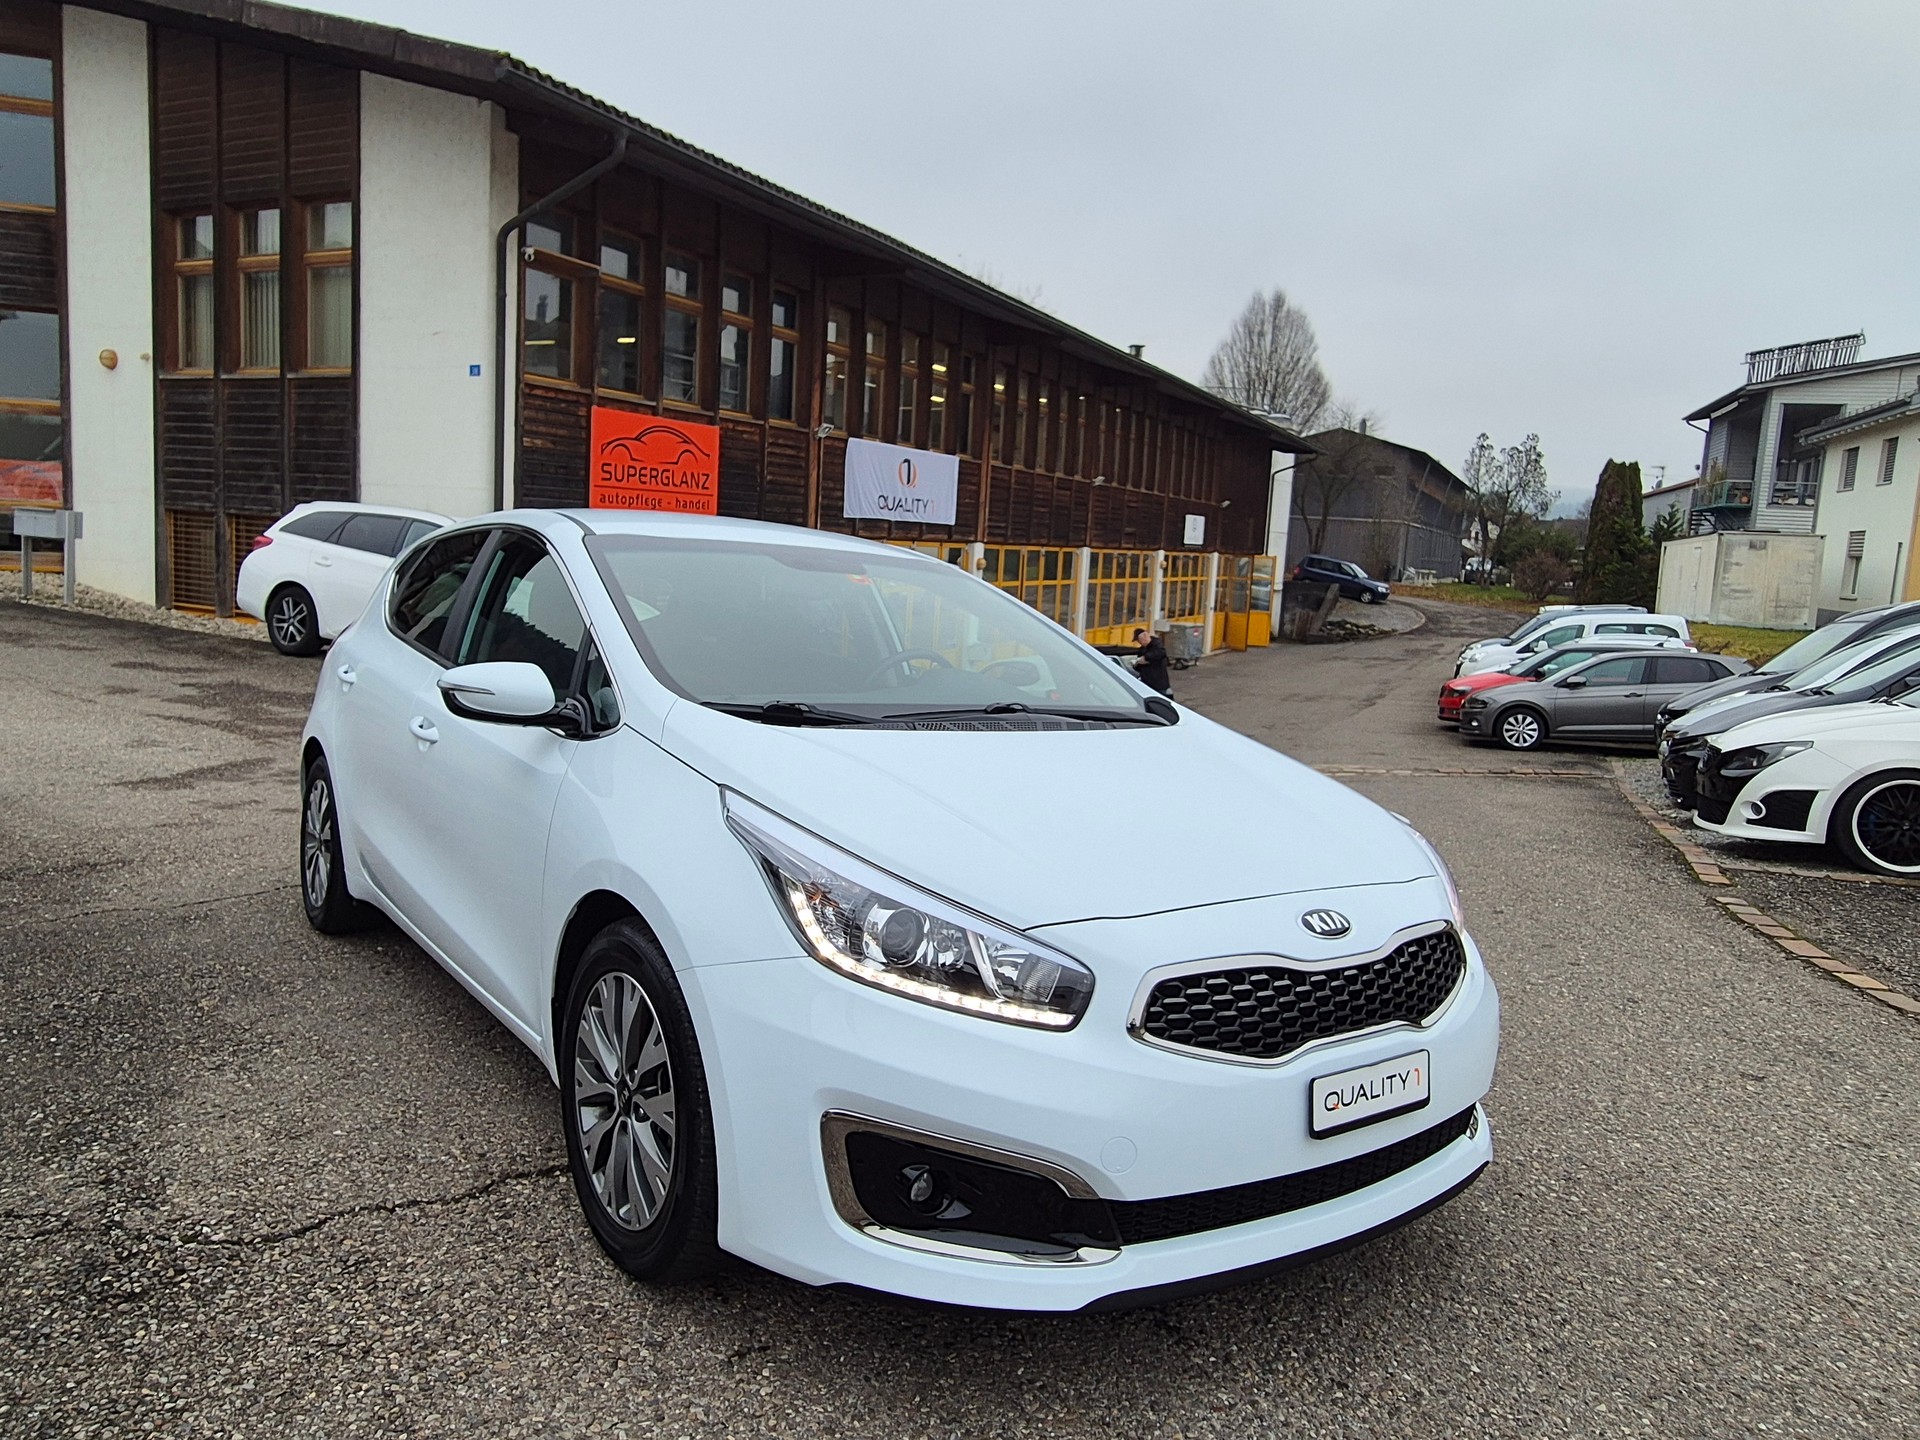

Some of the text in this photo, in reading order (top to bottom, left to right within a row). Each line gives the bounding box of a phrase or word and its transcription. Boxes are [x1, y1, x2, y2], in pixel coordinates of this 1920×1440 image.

[601, 462, 710, 490] SUPERGLANZ
[599, 492, 663, 510] autopflege
[675, 497, 710, 510] handel
[1304, 911, 1350, 933] KIA
